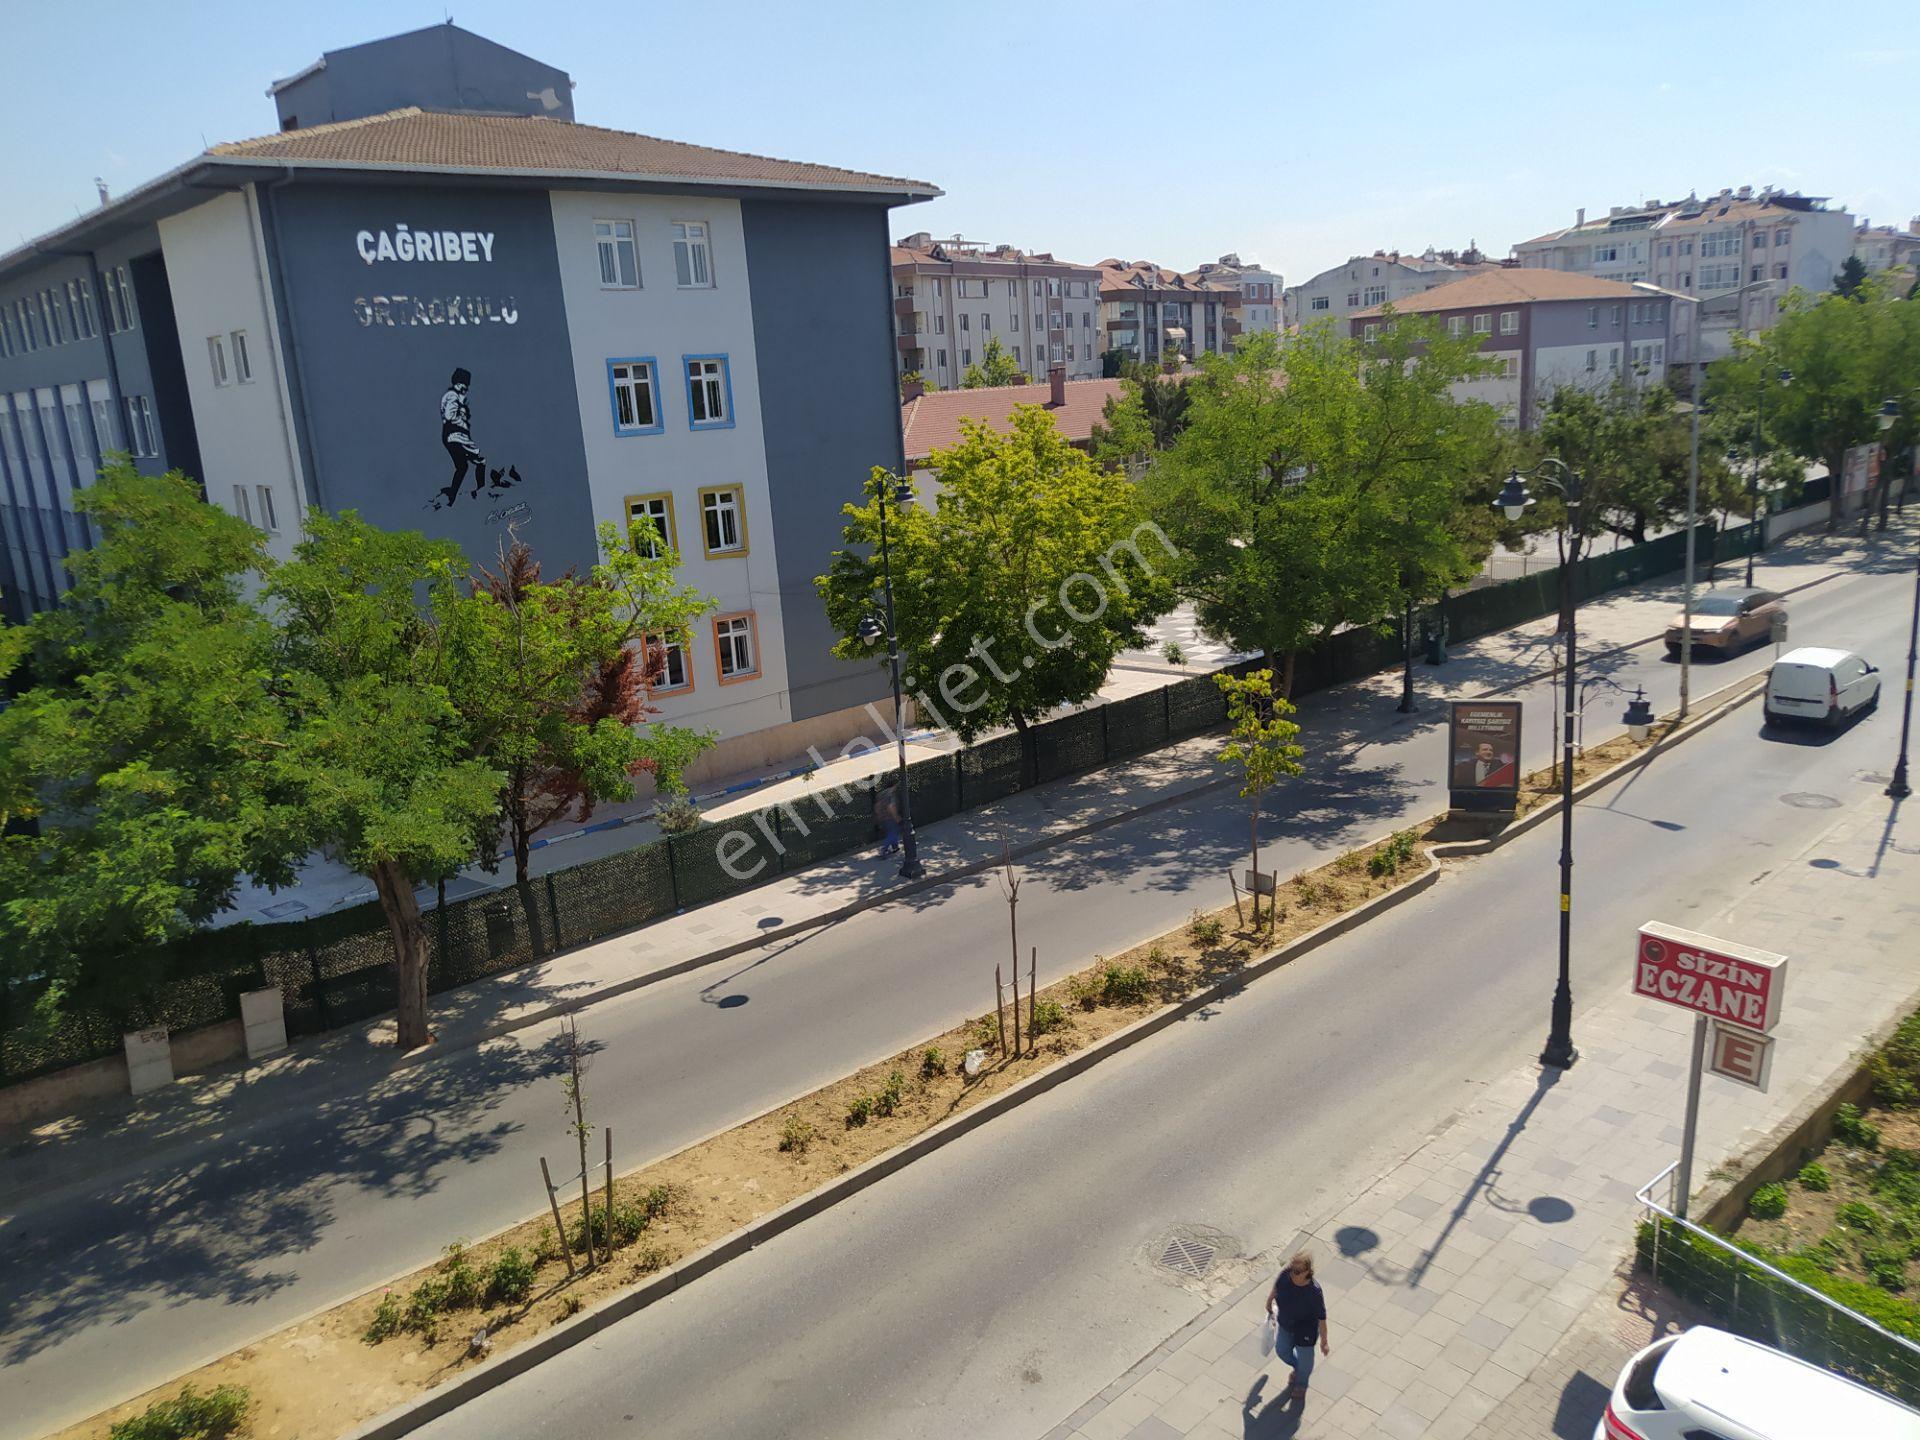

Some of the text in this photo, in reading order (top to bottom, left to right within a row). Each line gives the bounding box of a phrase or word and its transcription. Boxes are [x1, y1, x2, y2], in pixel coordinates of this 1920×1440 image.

[356, 223, 495, 265] ÇAĞRIBEY
[1676, 952, 1764, 990] SİZİN
[1638, 962, 1764, 1024] ECZANE
[1721, 1034, 1755, 1077] E
